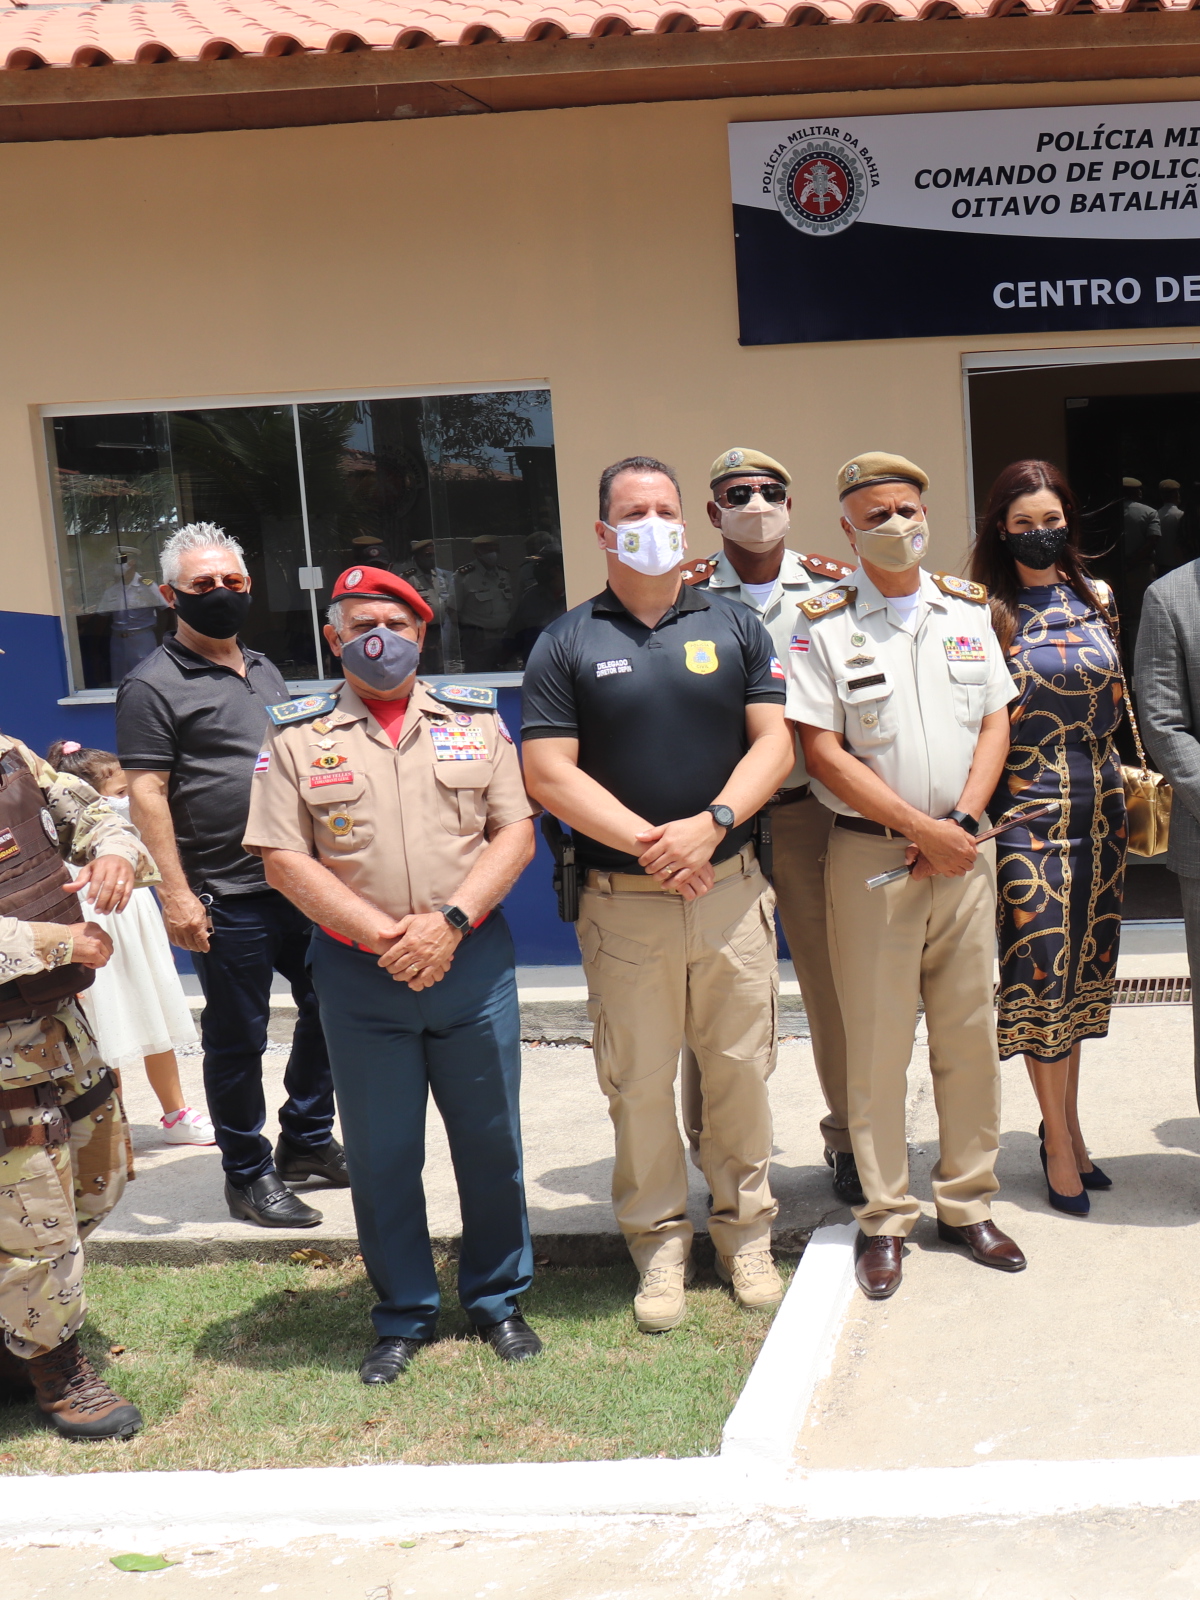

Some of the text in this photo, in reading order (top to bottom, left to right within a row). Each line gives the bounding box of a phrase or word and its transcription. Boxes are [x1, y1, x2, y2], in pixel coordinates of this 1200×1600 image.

[1037, 124, 1154, 153] POLÍCIA
[762, 126, 880, 194] POLÍCIA MILITAR DA BAHIA
[914, 163, 1057, 190] COMANDO
[1066, 161, 1104, 183] DE
[951, 194, 1061, 219] OITAVO
[993, 277, 1142, 309] CENTRO
[596, 658, 628, 671] DELEGADO
[596, 667, 618, 678] DIRETOR
